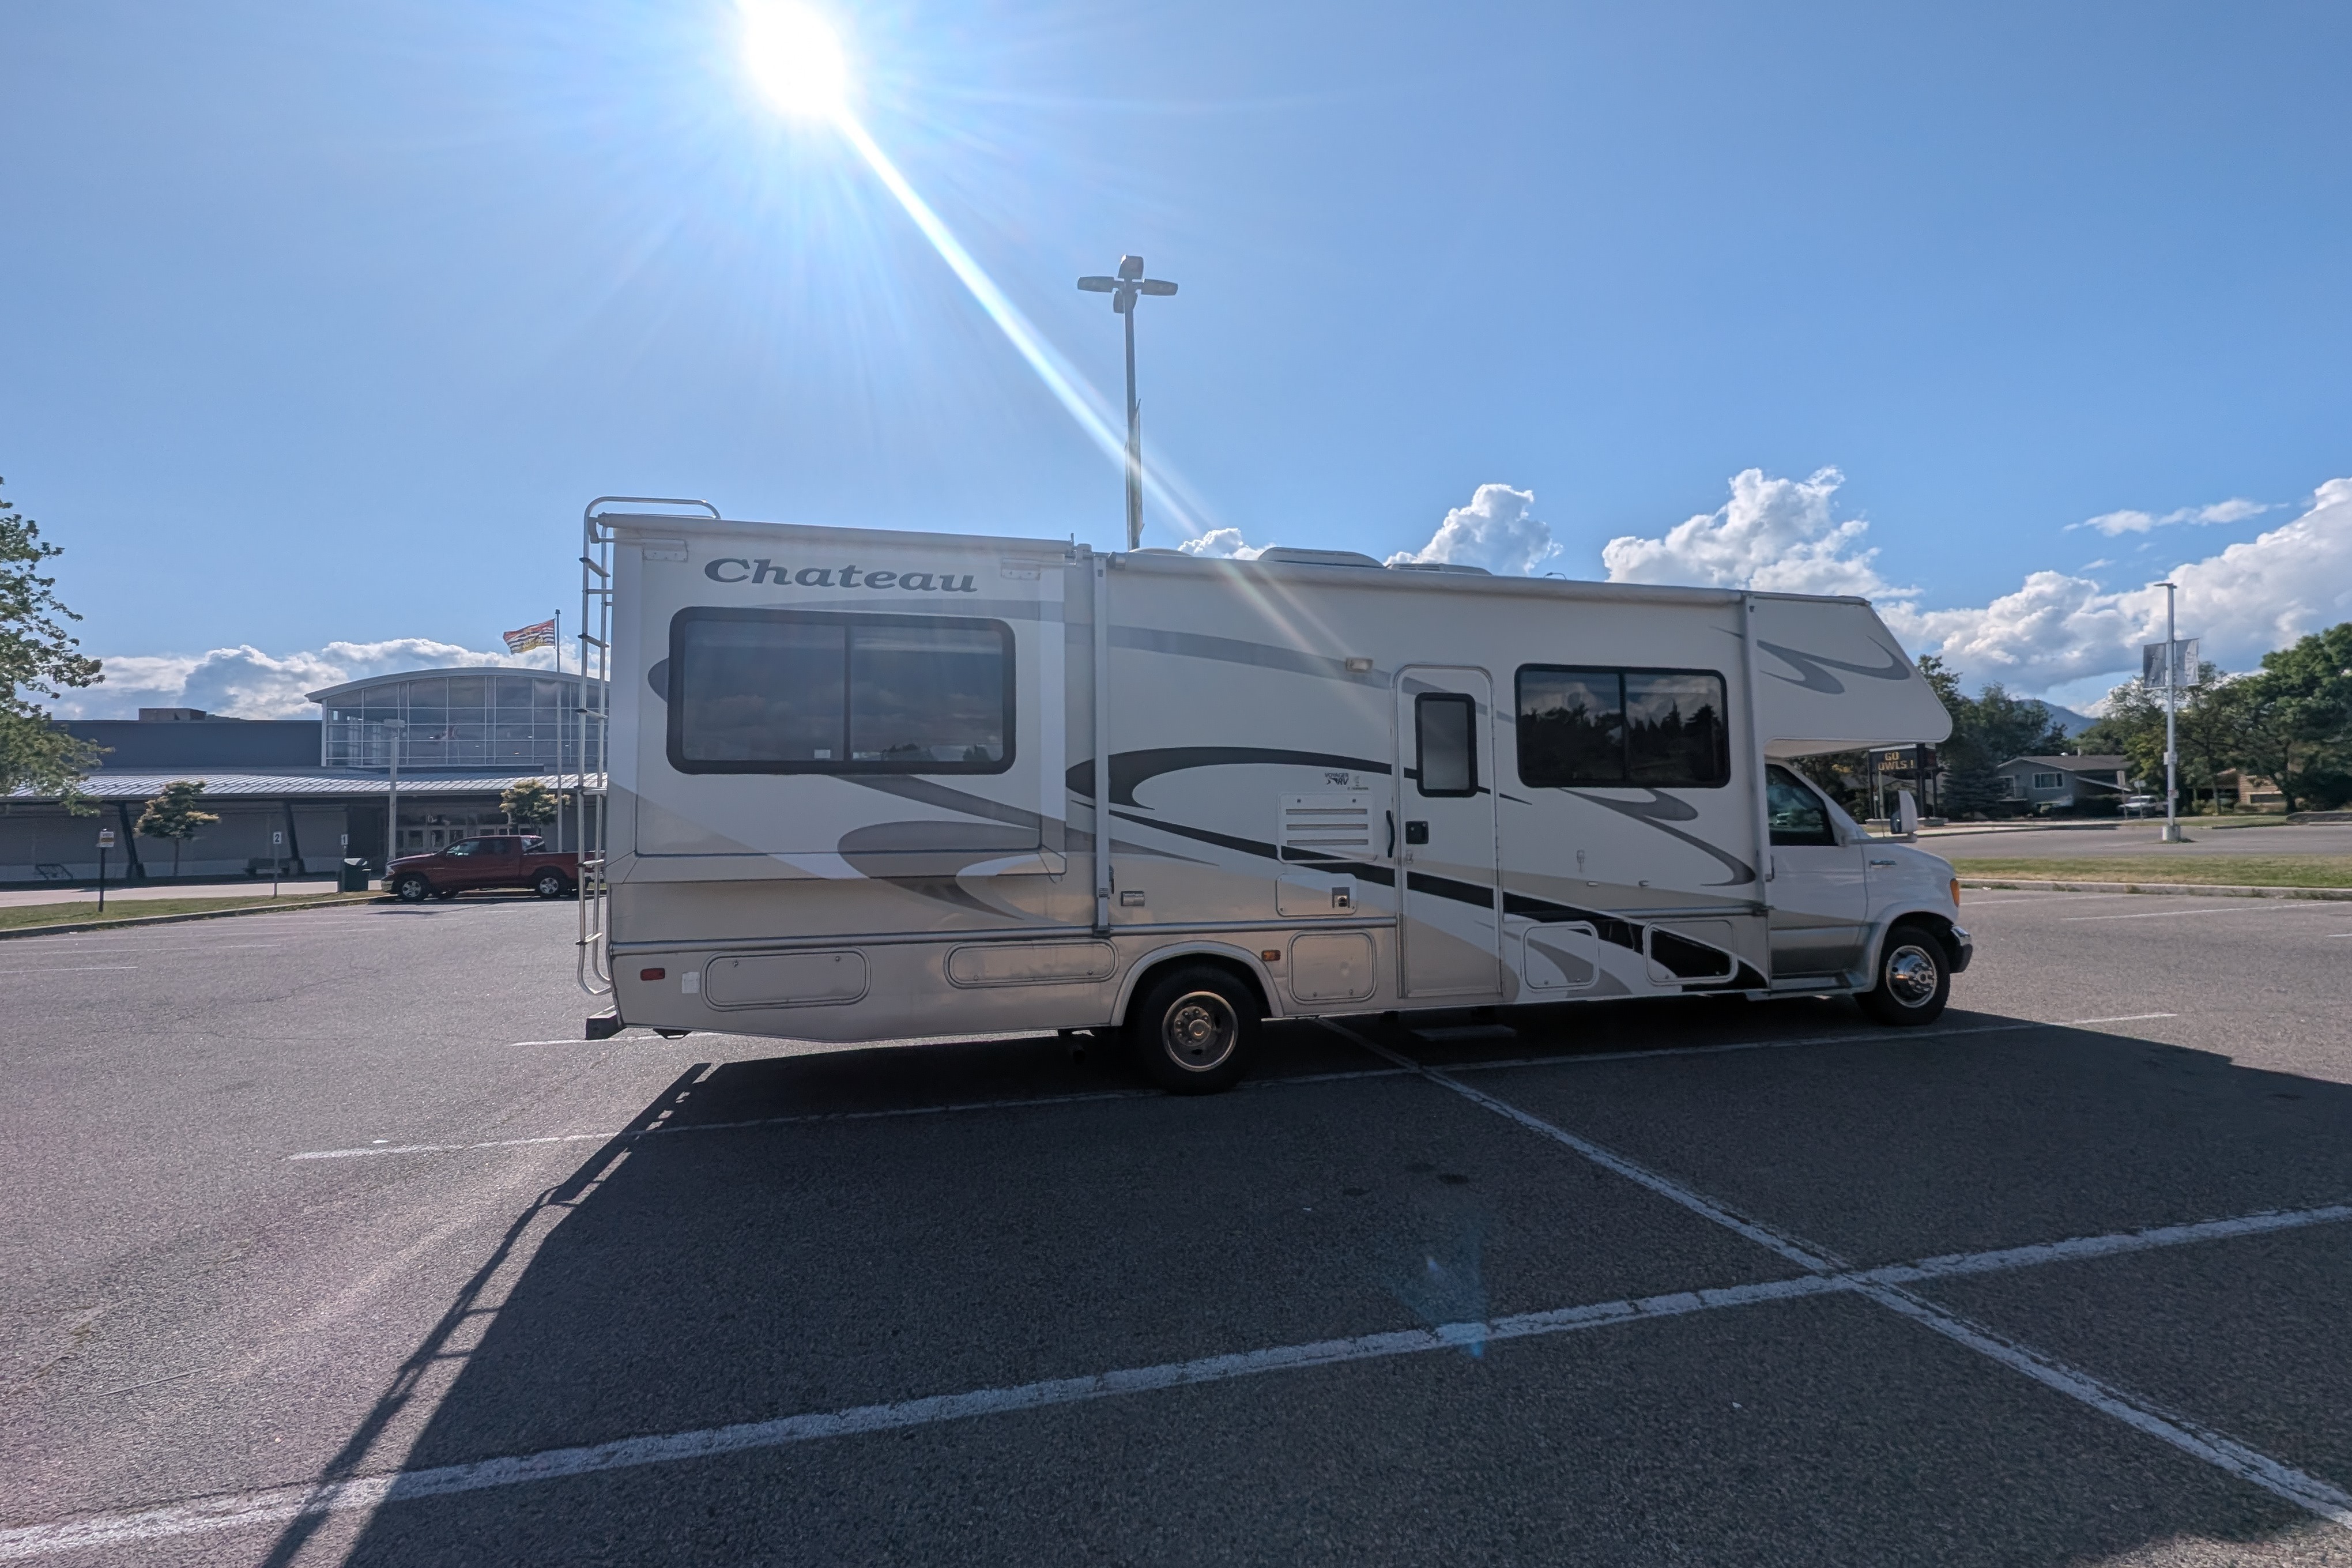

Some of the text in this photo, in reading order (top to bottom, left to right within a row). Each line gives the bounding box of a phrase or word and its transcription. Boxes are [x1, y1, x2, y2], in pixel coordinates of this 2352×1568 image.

[704, 557, 978, 593] Chateau
[1884, 751, 1900, 761] GO
[274, 834, 280, 843] 2
